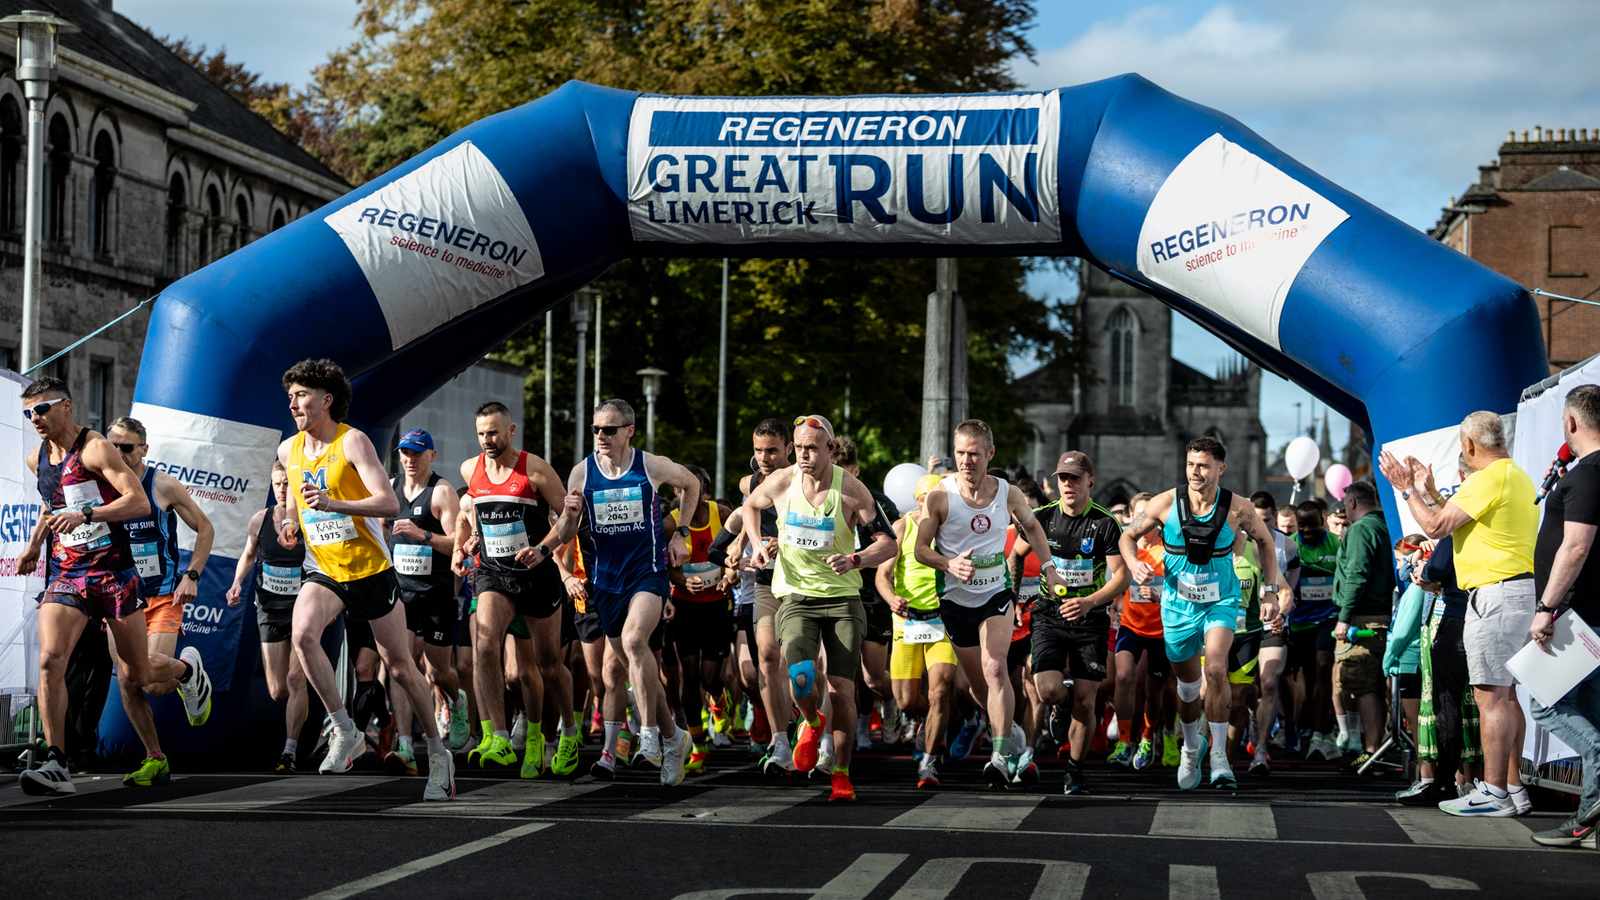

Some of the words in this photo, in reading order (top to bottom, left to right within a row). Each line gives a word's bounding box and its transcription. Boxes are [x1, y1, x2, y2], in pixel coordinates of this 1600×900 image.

[717, 114, 968, 143] REGENERON
[647, 153, 819, 194] GREAT
[828, 152, 1039, 226] RUN
[647, 200, 820, 226] LIMERICK
[358, 207, 528, 267] REGENERON
[1150, 202, 1311, 264] REGENERON
[389, 234, 439, 259] science
[440, 249, 455, 264] to
[1184, 248, 1224, 272] science
[1226, 242, 1238, 257] to
[316, 521, 343, 534] KARL
[607, 512, 629, 521] 2043
[632, 521, 646, 531] AC
[319, 533, 341, 541] 1975
[796, 537, 818, 547] 2176
